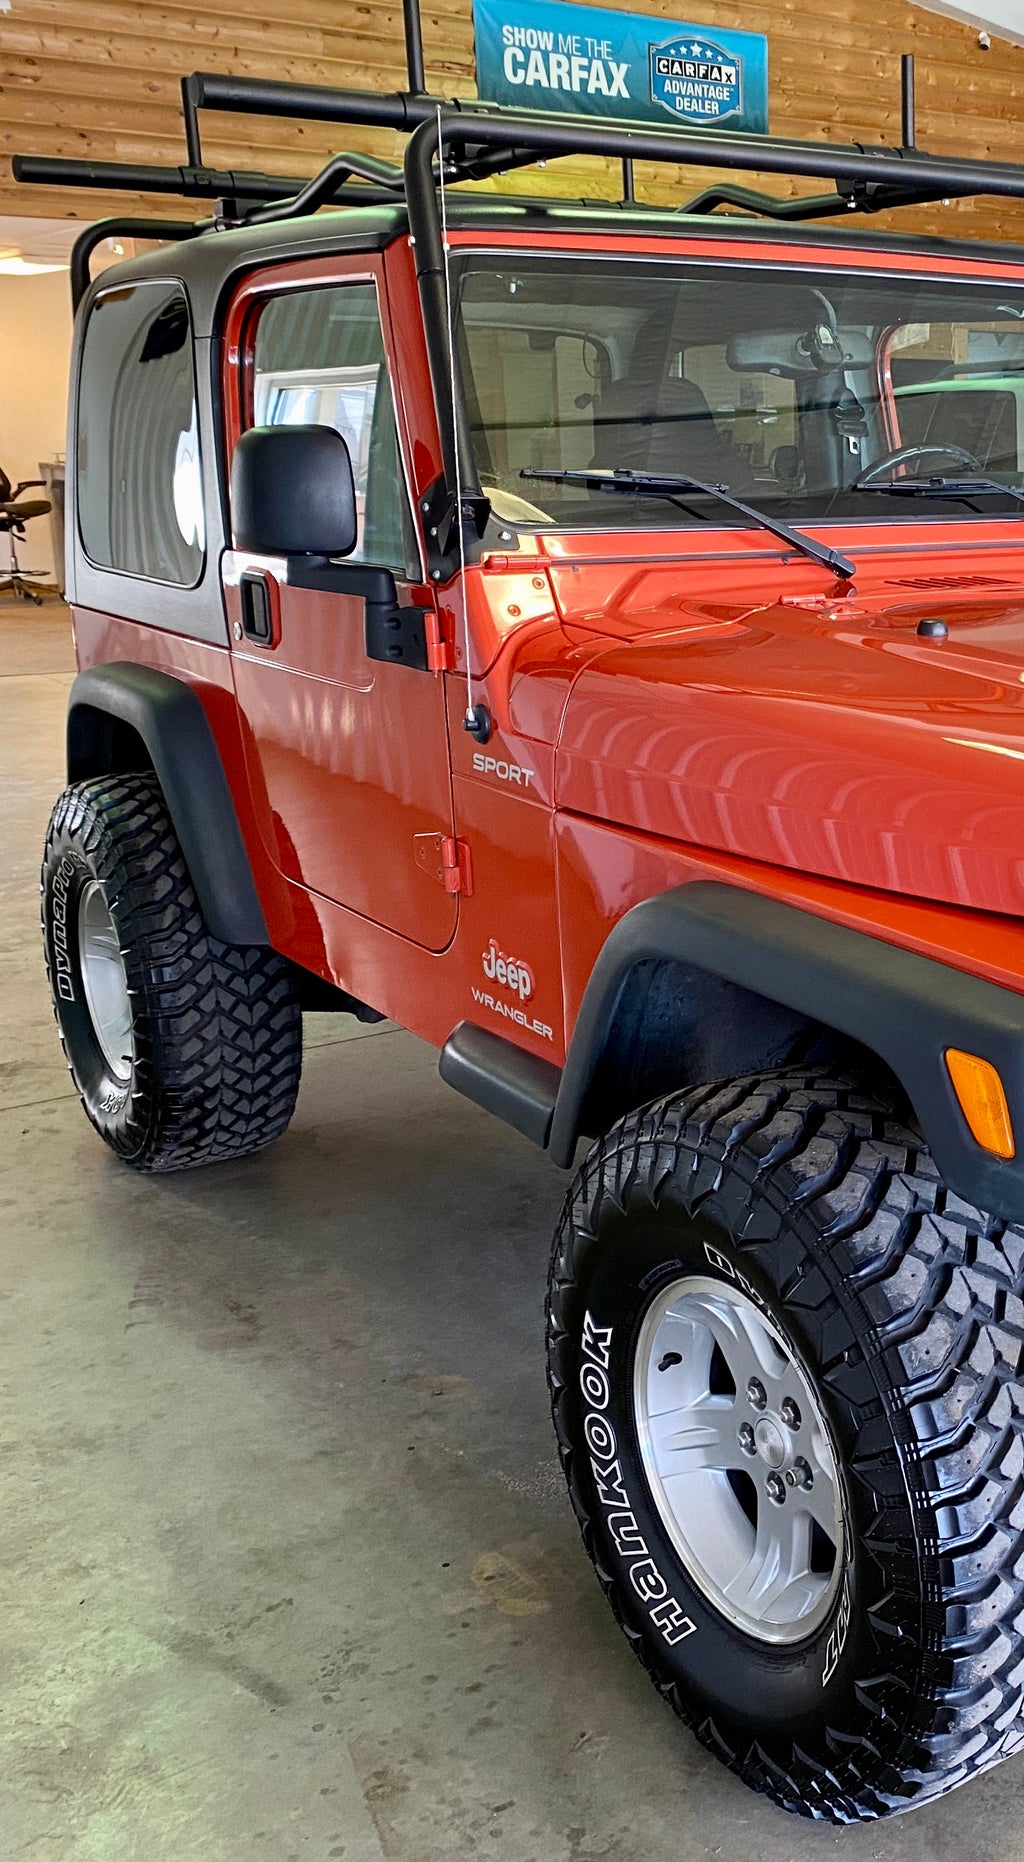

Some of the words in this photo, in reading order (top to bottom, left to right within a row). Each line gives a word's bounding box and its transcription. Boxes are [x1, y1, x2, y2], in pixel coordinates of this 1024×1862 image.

[502, 25, 553, 52] SHOW
[558, 33, 581, 56] ME
[584, 37, 613, 61] THE
[503, 46, 631, 99] CARFAX
[659, 59, 733, 84] CARFAX
[664, 79, 731, 101] ADVANTAGE
[675, 97, 719, 115] DEALER
[472, 752, 535, 787] SPORT
[482, 939, 531, 1000] Jeep
[471, 986, 554, 1042] WRANGLER
[580, 1310, 697, 1646] Hankook
